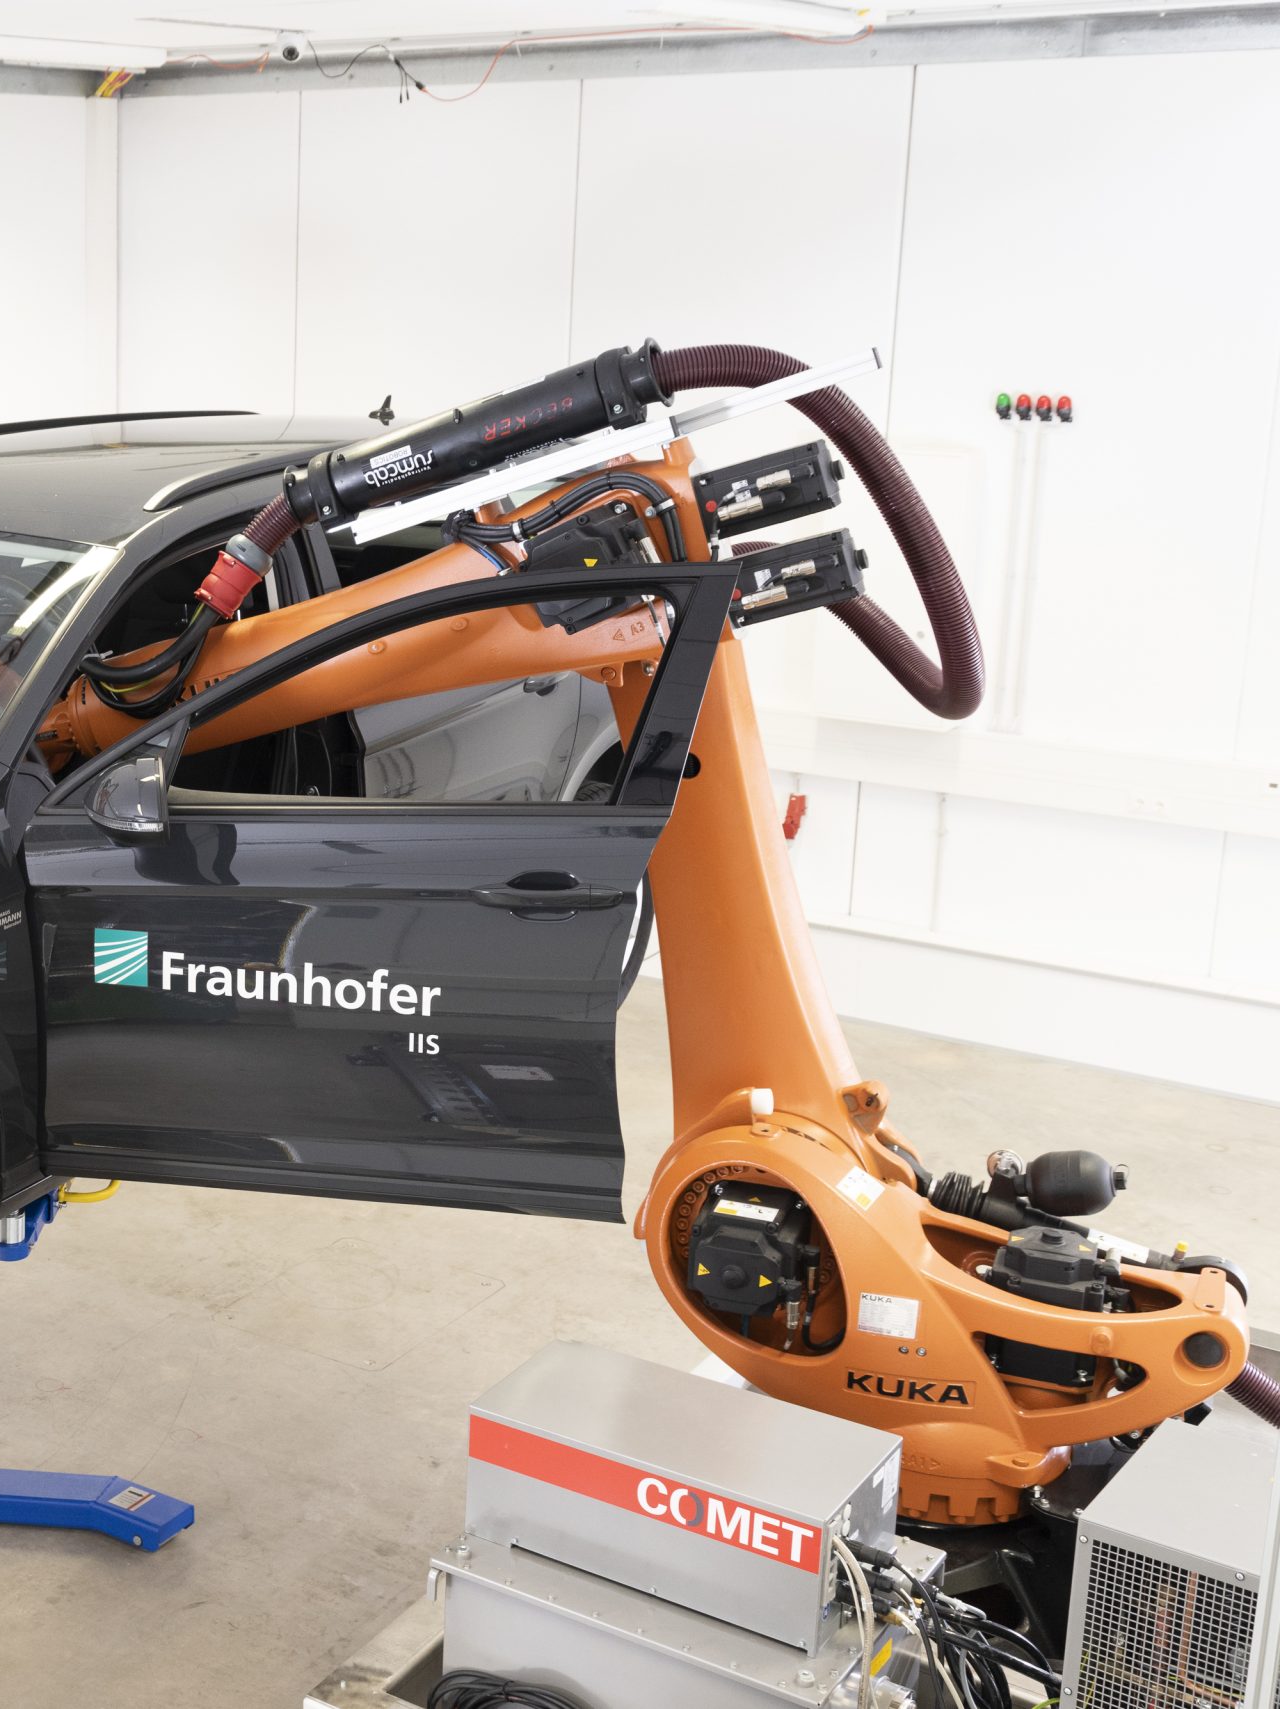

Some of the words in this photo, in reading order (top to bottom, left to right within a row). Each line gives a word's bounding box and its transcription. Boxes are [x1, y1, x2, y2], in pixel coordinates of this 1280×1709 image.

[482, 396, 574, 442] BECKER
[363, 449, 433, 488] sumcab
[162, 950, 442, 1017] Fraunhofer
[408, 1032, 441, 1055] IIS
[861, 1293, 893, 1304] KUKA
[847, 1371, 969, 1405] KUKA
[636, 1477, 815, 1564] COMET
